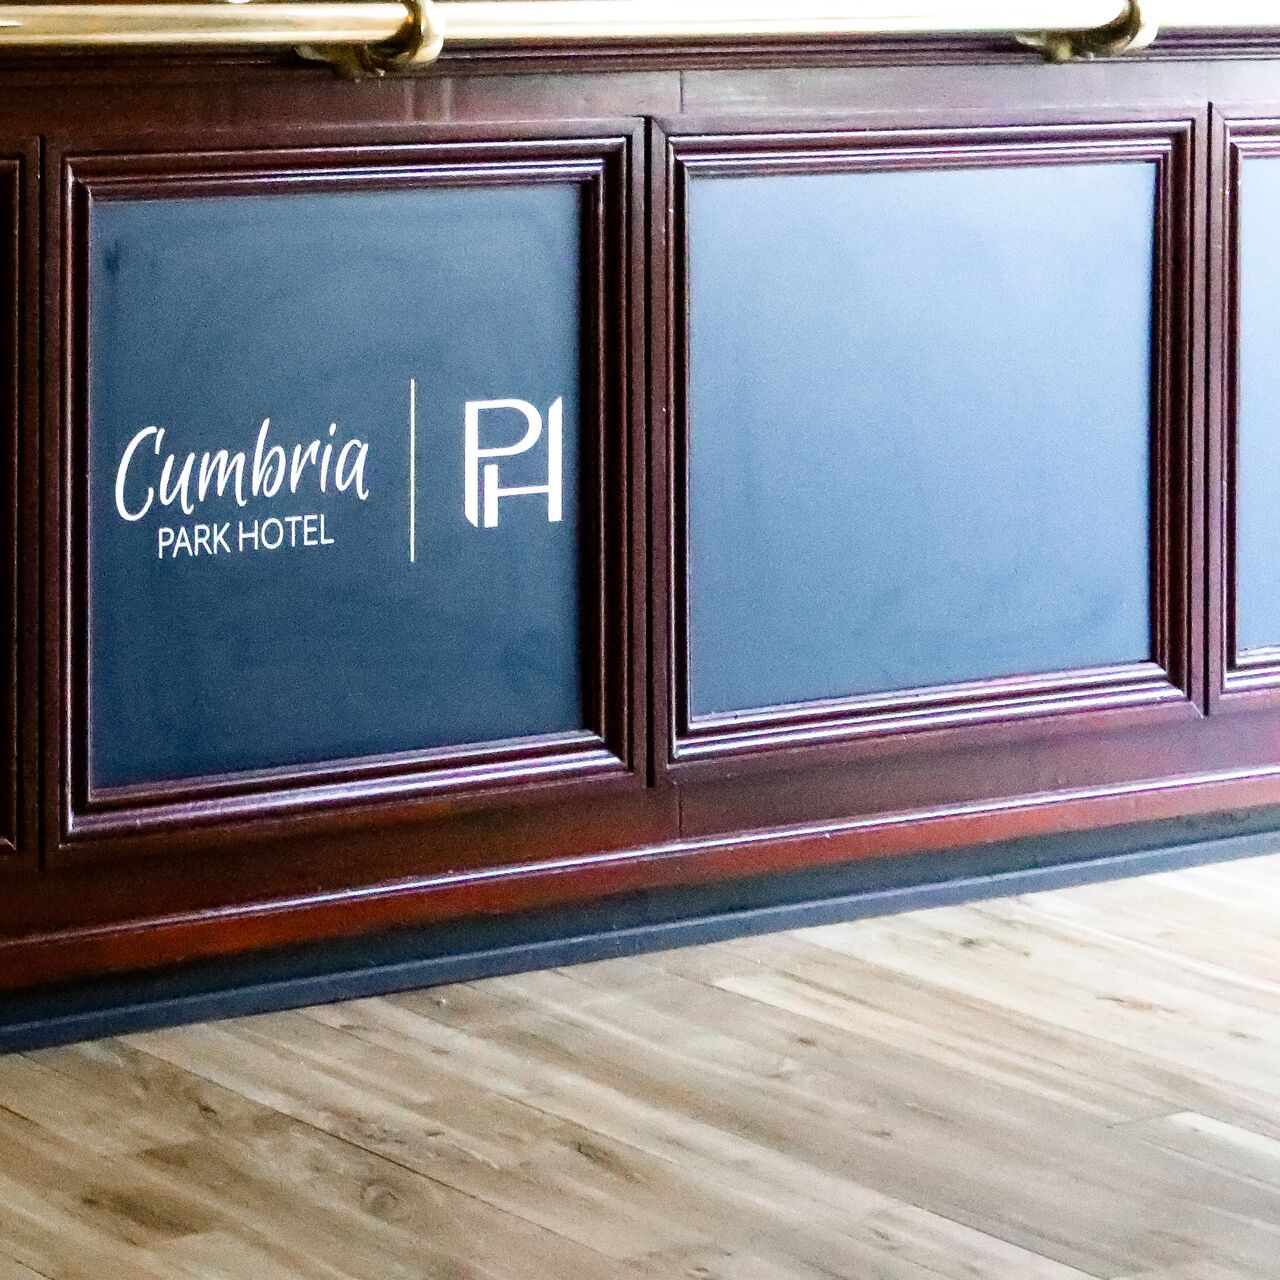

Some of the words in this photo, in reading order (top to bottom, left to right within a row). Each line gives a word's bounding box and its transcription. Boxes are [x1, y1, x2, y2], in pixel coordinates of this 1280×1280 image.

[114, 417, 370, 523] Cumbria
[157, 522, 232, 559] PARK
[238, 514, 335, 553] HOTEL
